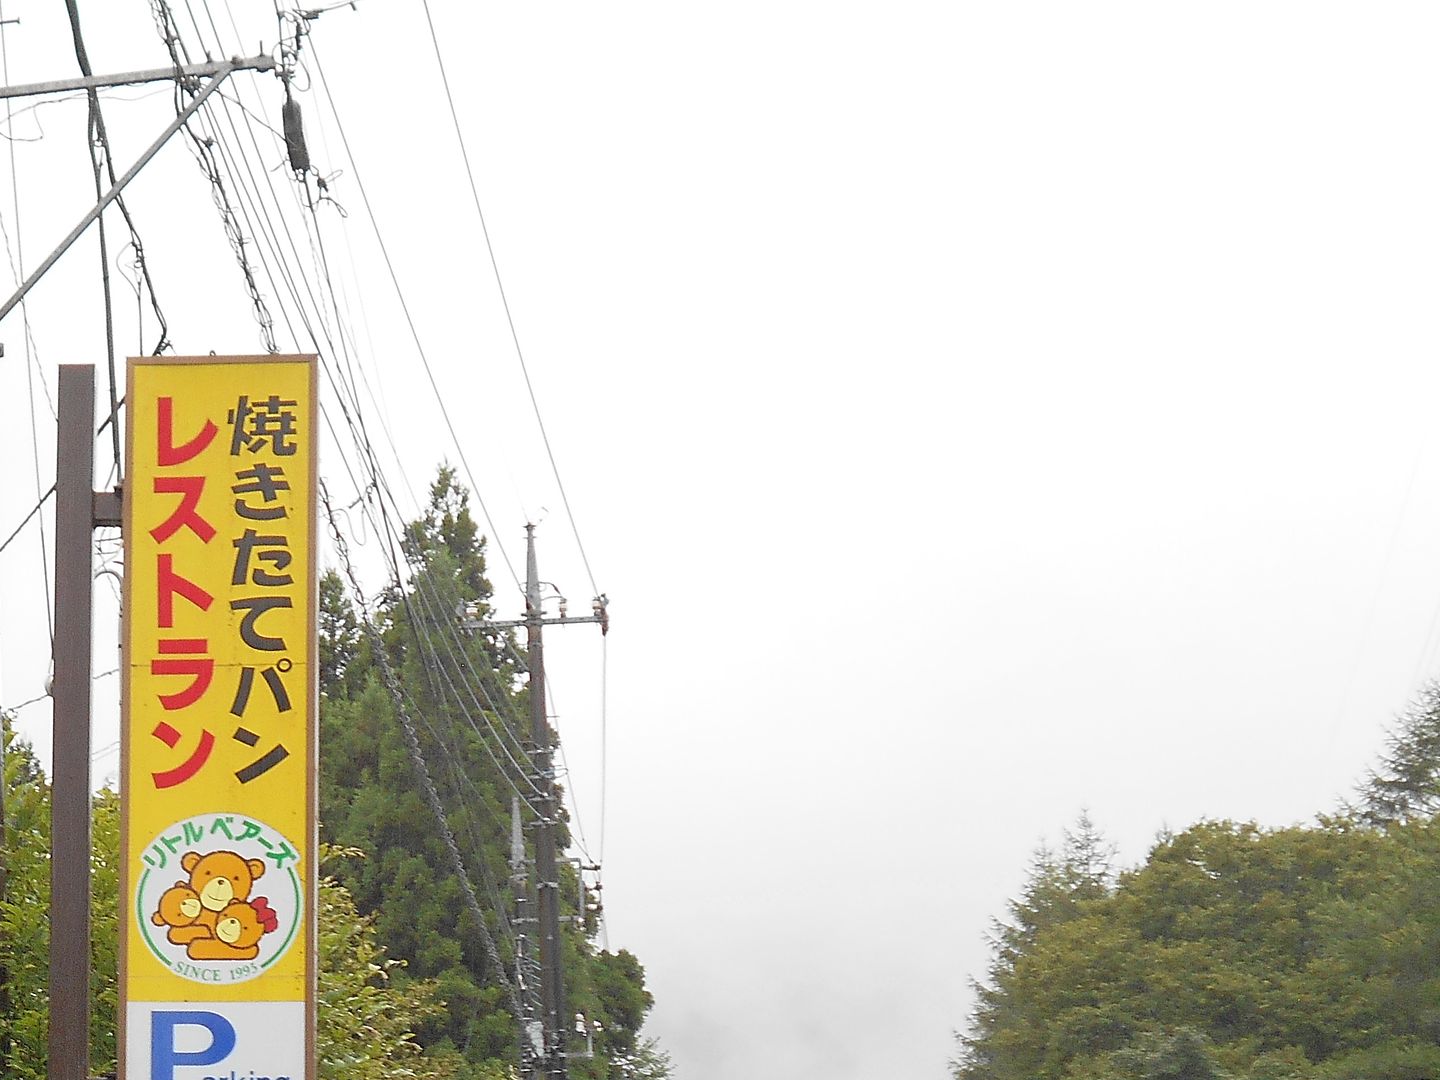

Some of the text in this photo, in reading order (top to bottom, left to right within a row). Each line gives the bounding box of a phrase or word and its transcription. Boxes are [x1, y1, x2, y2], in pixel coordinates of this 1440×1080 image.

[149, 396, 219, 789] レストラン
[227, 395, 298, 785] 焼きたてパン
[174, 962, 260, 981] SINCE 1995
